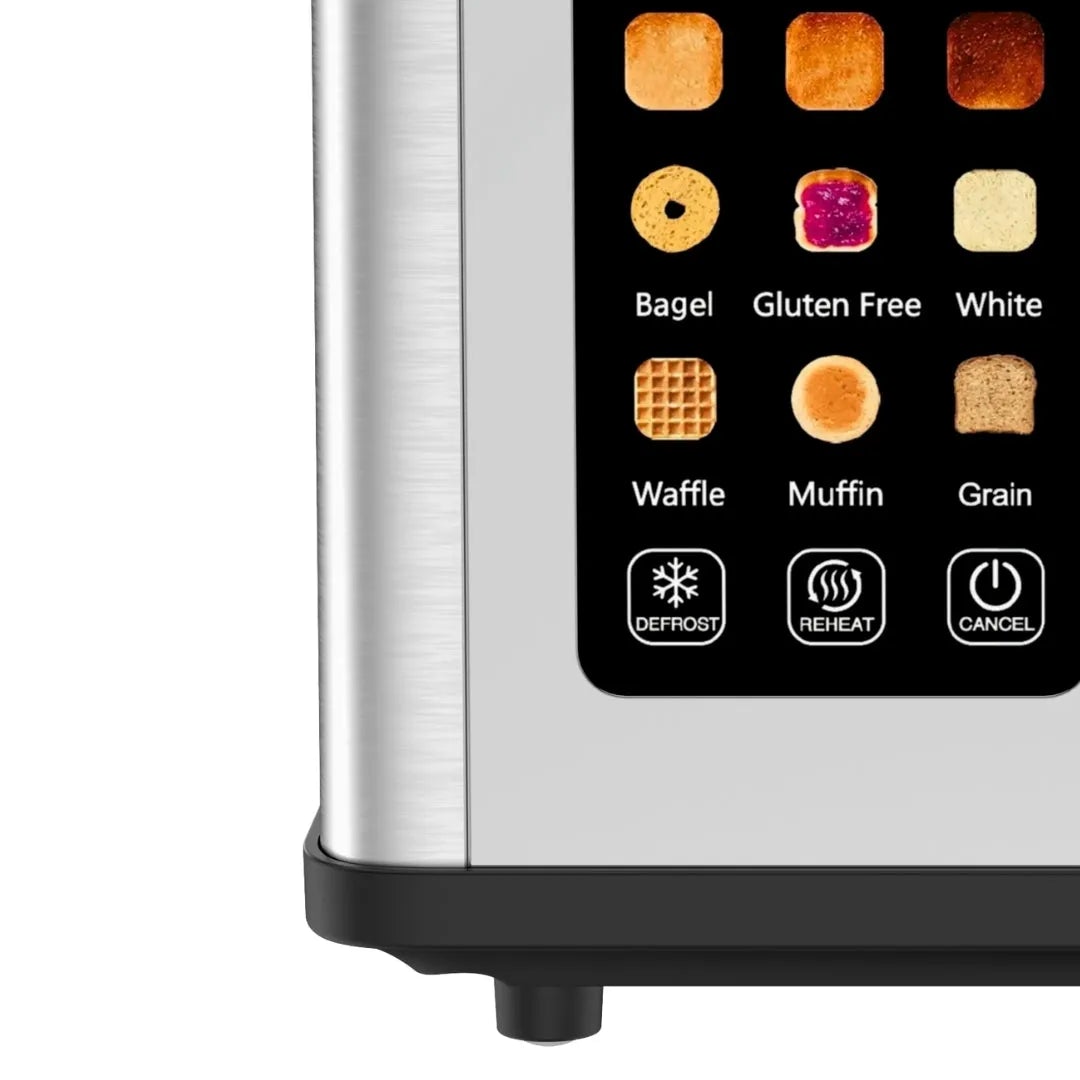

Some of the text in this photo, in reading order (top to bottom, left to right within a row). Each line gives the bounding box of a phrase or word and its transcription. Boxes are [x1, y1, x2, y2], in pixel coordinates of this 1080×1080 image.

[636, 291, 713, 322] Bagel
[753, 291, 922, 318] Gluten Free
[955, 291, 1043, 318] White
[631, 479, 726, 507] Waffle
[789, 479, 884, 507] Muffin
[958, 481, 1032, 507] Grain
[635, 616, 720, 633] DEFROST
[799, 616, 875, 633] REHEAT
[958, 616, 1036, 633] CANCEL
